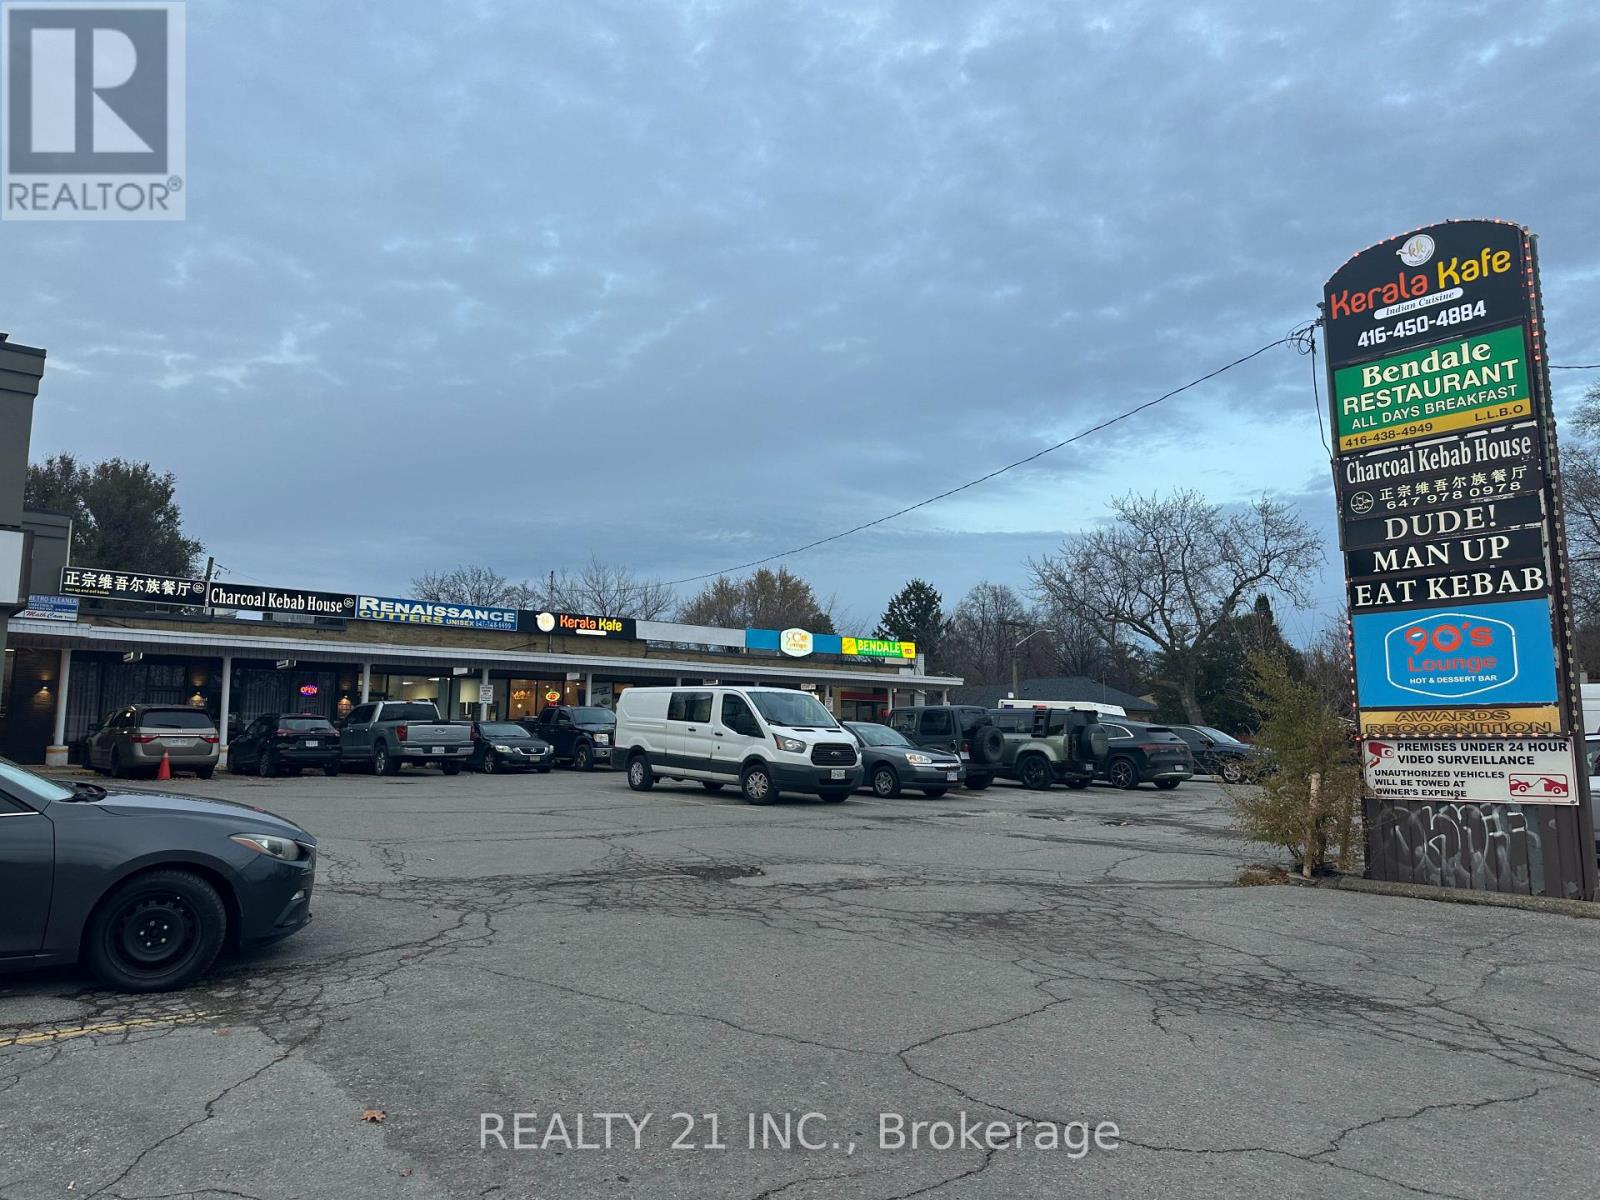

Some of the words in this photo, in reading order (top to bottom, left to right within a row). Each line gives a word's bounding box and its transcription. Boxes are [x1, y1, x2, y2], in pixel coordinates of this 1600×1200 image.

[1330, 272, 1429, 320] Kerala
[1437, 247, 1512, 290] Kafe
[1385, 299, 1416, 317] Indian
[1418, 290, 1456, 307] Cuisine
[1357, 300, 1487, 348] 416-450-4884
[1361, 341, 1492, 389] Bendale
[1343, 358, 1519, 416] RESTAURANT
[1351, 415, 1378, 430] ALL
[1382, 405, 1420, 425] DAYS
[1424, 384, 1518, 415] BREAKFAST
[1474, 404, 1524, 422] L.L.B.O
[1345, 422, 1434, 448] 416-438-4949
[1346, 449, 1415, 485] Charcoal
[1418, 438, 1472, 472] Kebab
[1475, 435, 1532, 462] House
[1379, 465, 1528, 501] 正宗维吾尔族餐厅
[1386, 497, 1419, 510] 647
[1427, 491, 1463, 504] 978
[1469, 482, 1521, 497] 0978
[1384, 504, 1497, 541] DUDE!
[1373, 543, 1450, 573] MAN
[1460, 535, 1510, 563] UP
[64, 570, 191, 597] 正宗维吾尔族餐厅
[1355, 580, 1417, 607] EAT
[1427, 567, 1544, 601] KEBAB
[211, 587, 265, 607] Charcoal
[268, 592, 304, 610] Kebab
[307, 596, 343, 613] House
[358, 610, 443, 624] CUTTERS
[446, 618, 474, 628] UNISEX
[560, 614, 596, 630] Kerala
[599, 617, 622, 631] Kafe
[857, 639, 901, 653] BENDALE
[1404, 621, 1493, 655] 90's
[1407, 655, 1498, 674] Lounge
[1409, 677, 1427, 685] HOT
[1429, 676, 1436, 684] &
[1437, 675, 1476, 684] DESSERT
[1478, 674, 1497, 682] BAR
[1366, 722, 1551, 734] RECOGNITION
[1395, 710, 1511, 722] AWARDS
[1397, 742, 1457, 752] PREMISES
[1460, 742, 1505, 753] UNDER
[1508, 742, 1524, 752] 24
[1528, 742, 1568, 753] HOUR
[1398, 755, 1434, 764] VIDEO
[1437, 755, 1535, 765] SURVEILLANCE
[1374, 769, 1450, 778] UNAUTHORIZED
[1453, 770, 1505, 779] VEHICLES
[1375, 778, 1398, 786] WILL
[1400, 779, 1413, 787] BE
[1416, 779, 1450, 788] TOWED
[1453, 780, 1465, 788] AT
[1376, 788, 1419, 796] OWNER'S
[1421, 789, 1467, 798] EXPENSE
